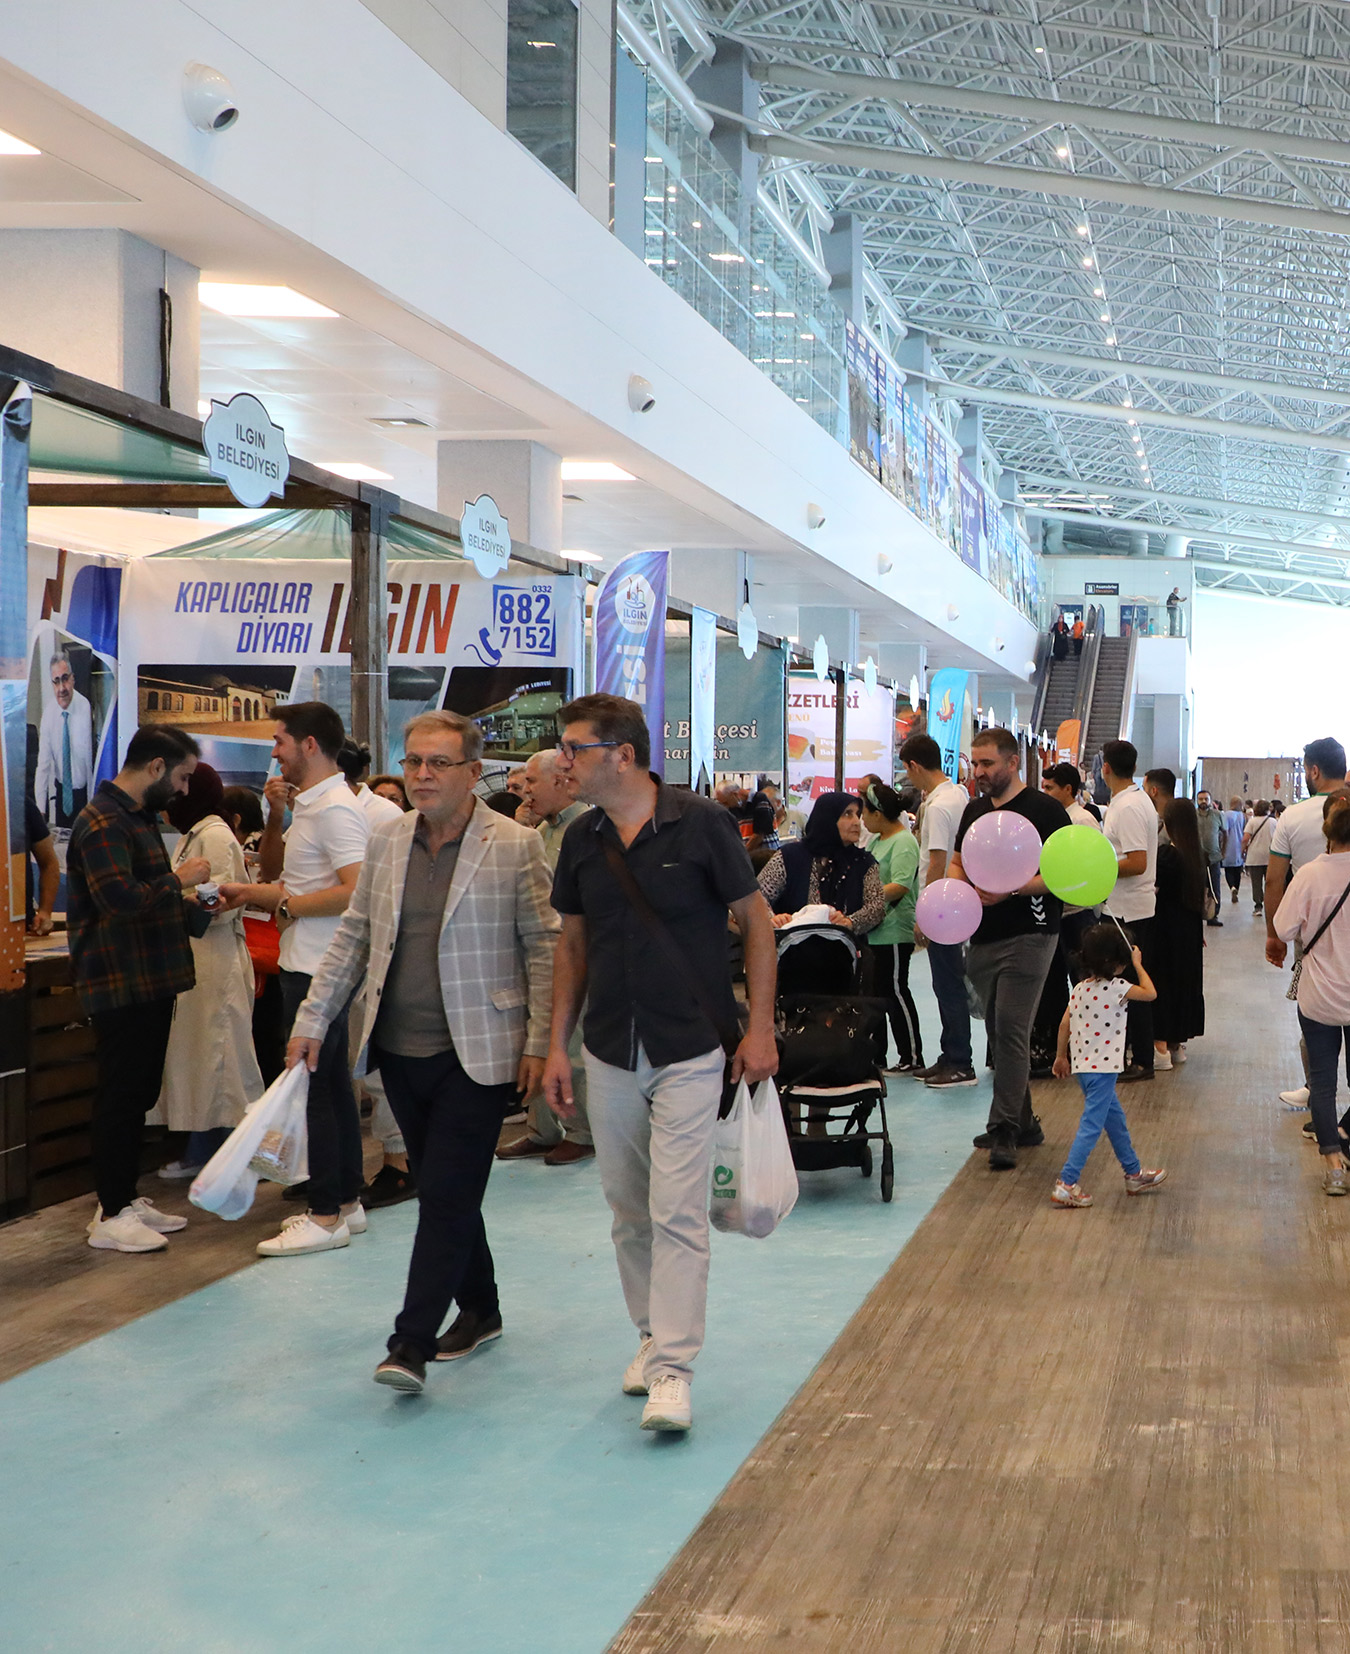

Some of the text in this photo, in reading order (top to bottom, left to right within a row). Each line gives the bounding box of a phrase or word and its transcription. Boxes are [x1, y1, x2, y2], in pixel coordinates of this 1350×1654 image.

[235, 422, 266, 450] ILGIN
[217, 442, 281, 481] BELEDİYESİ
[478, 517, 498, 537] ILGIN
[467, 533, 506, 559] BELEDİYESİ
[174, 581, 313, 613] KAPLICALAR
[531, 585, 553, 593] 0332
[500, 593, 551, 624] 882
[623, 608, 648, 620] ILGIN
[236, 615, 313, 653] DİYARI
[500, 626, 551, 649] 7152
[788, 713, 810, 722] ENÜ
[676, 720, 758, 743] Bçesi
[943, 748, 955, 778] ESİ
